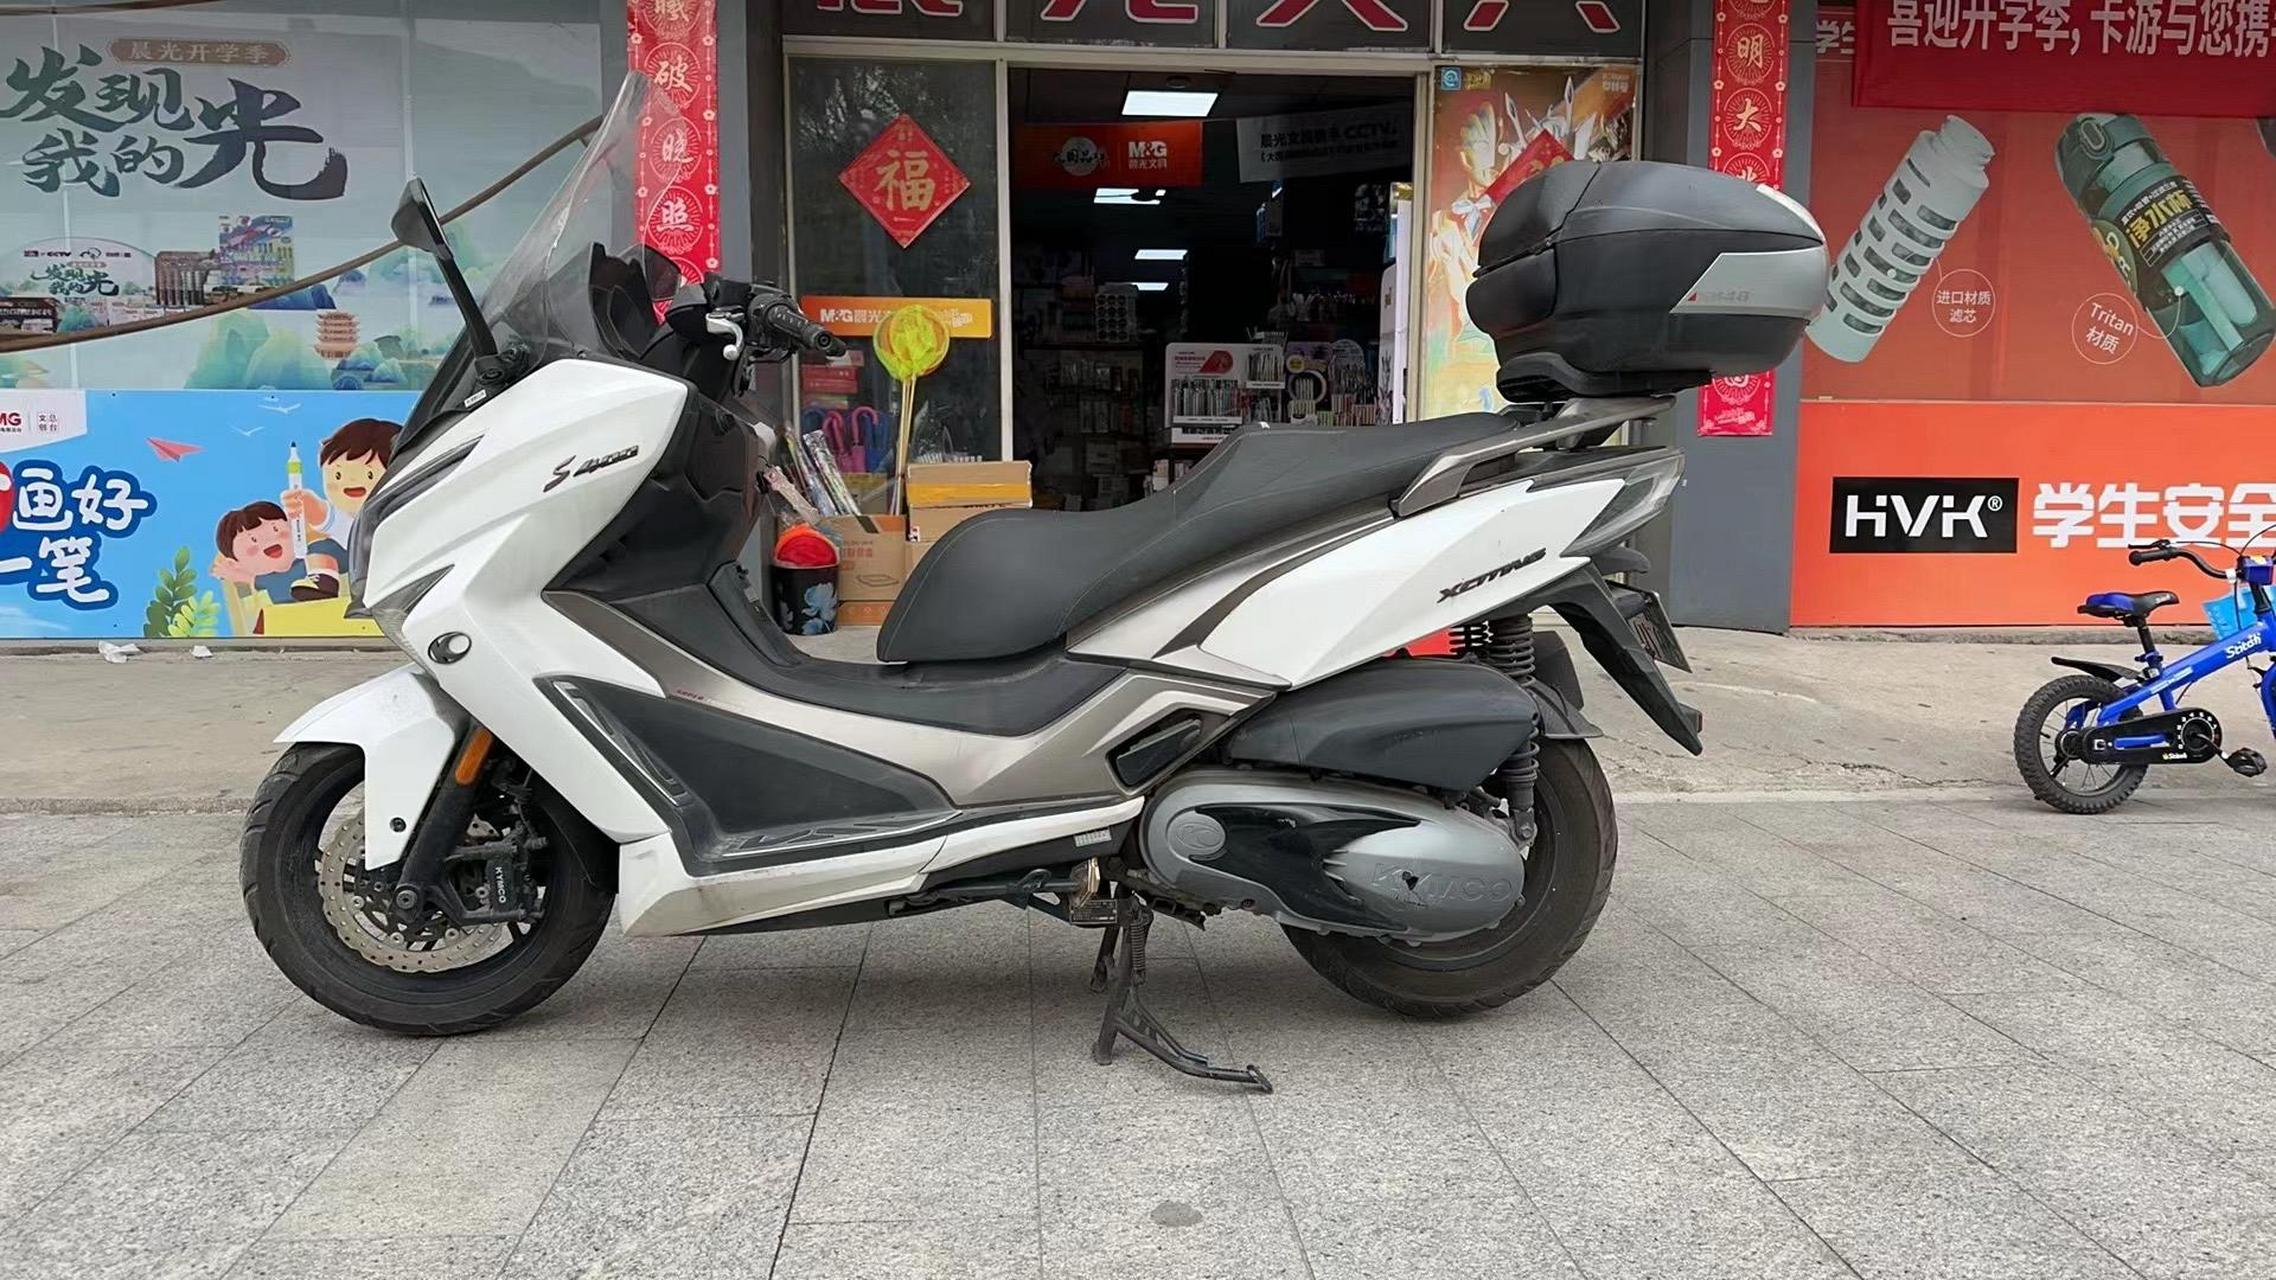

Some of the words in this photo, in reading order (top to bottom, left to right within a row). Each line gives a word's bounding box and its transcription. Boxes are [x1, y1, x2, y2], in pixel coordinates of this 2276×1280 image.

[1888, 0, 2276, 57] 喜迎开学季，卡游与您携
[131, 42, 269, 63] 晨光开学季
[0, 44, 195, 132] 发现
[1128, 141, 1168, 158] M&G
[873, 149, 936, 211] 福
[1936, 290, 1991, 305] 进口材质
[1949, 308, 1976, 324] 滤芯
[2090, 302, 2134, 336] Tritan
[2086, 326, 2119, 354] 材质
[543, 455, 577, 493] S
[0, 466, 149, 531] 画好
[2033, 482, 2276, 549] 学生安全
[0, 537, 110, 603] 一笔
[495, 866, 507, 904] KYMCO
